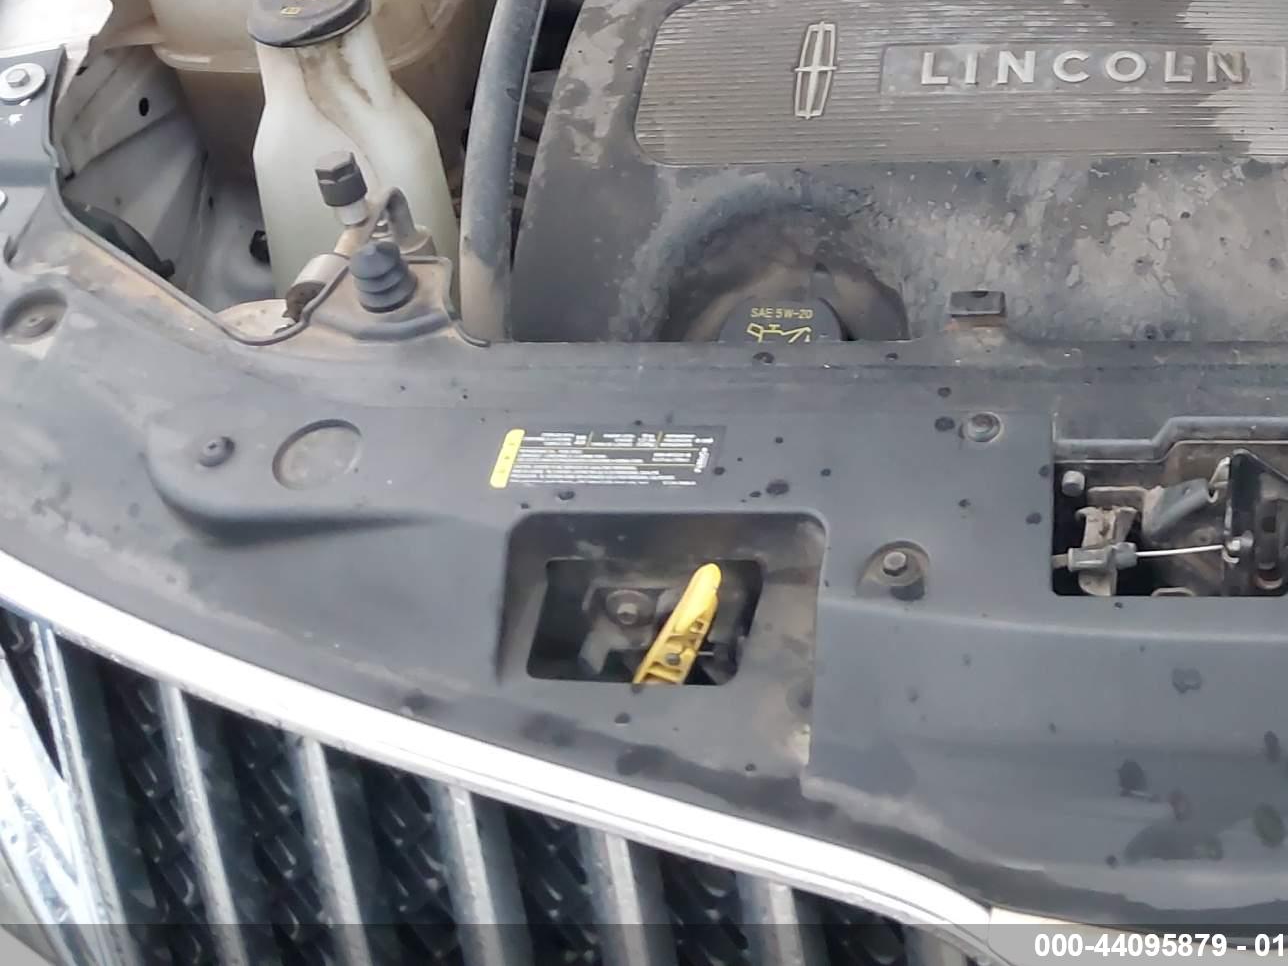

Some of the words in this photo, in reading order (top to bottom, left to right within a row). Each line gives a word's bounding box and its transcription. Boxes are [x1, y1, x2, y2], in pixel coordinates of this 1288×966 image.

[920, 49, 1247, 85] LINCOLN
[750, 307, 773, 318] SAE
[775, 308, 814, 319] 5W-20
